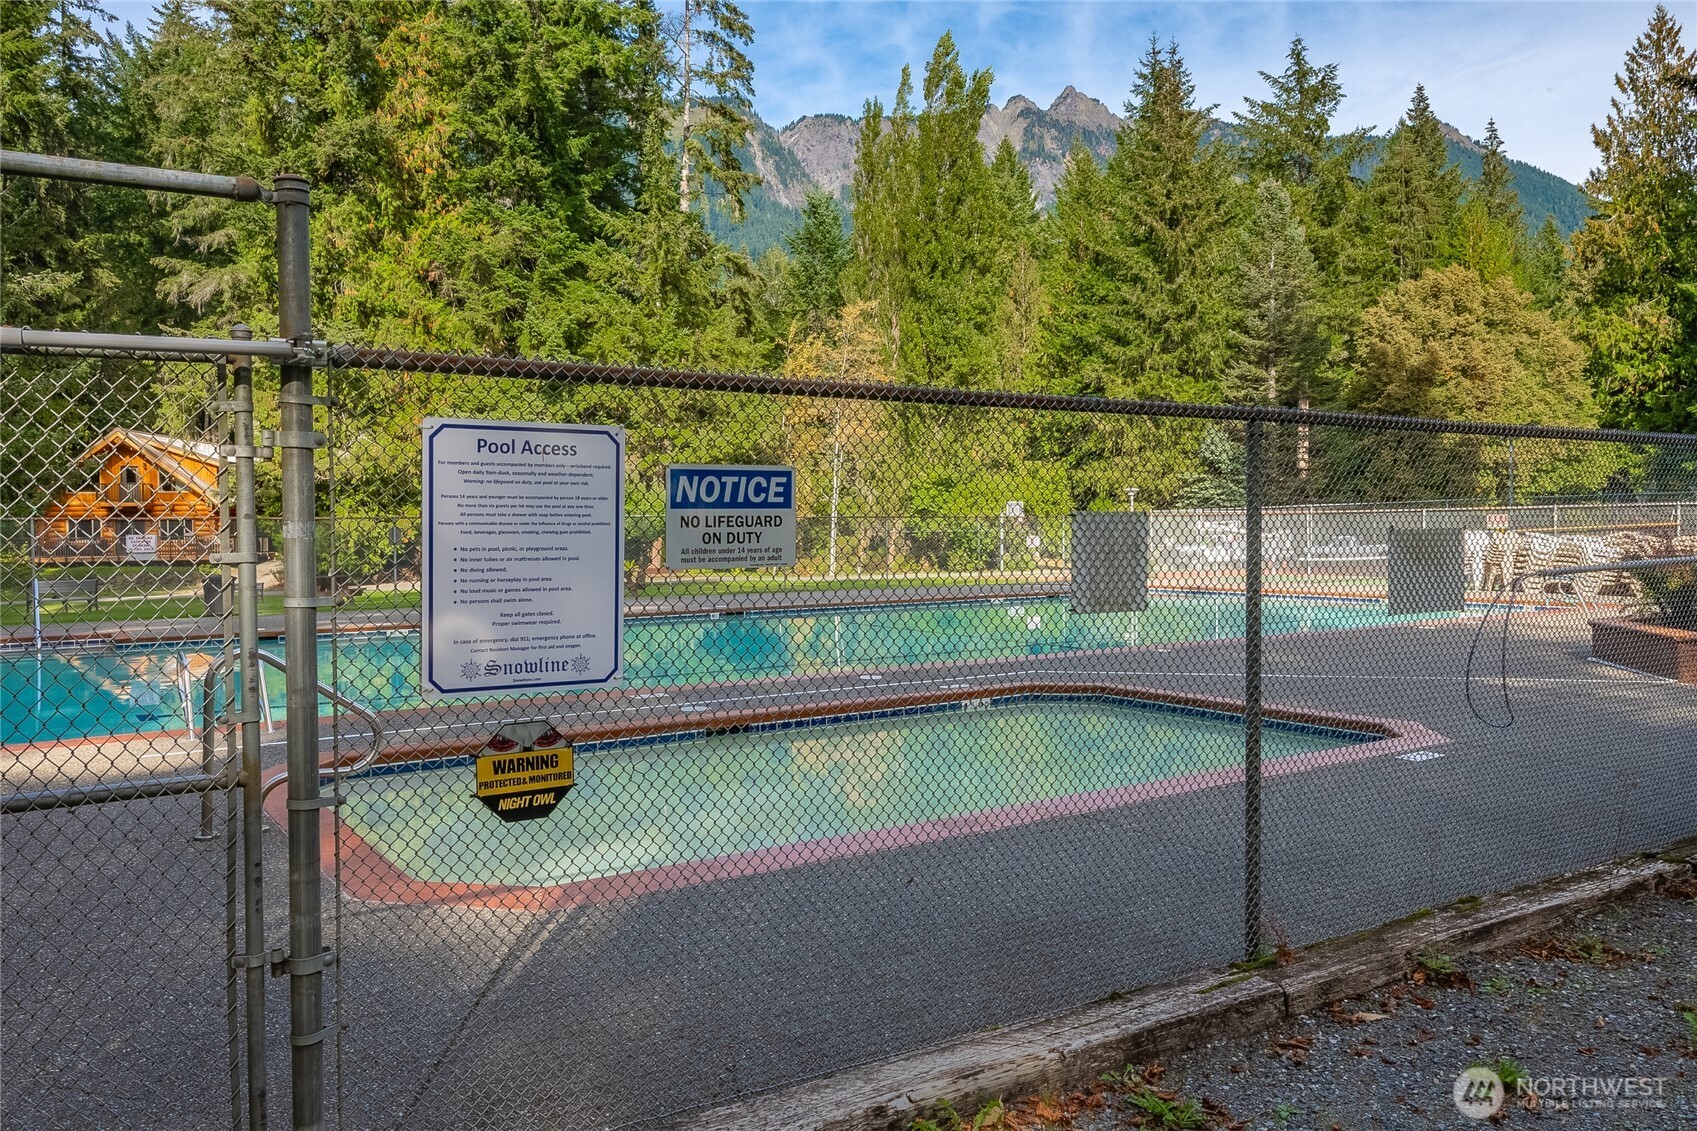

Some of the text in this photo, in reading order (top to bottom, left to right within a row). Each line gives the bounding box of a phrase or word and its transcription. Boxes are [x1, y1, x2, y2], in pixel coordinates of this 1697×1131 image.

[477, 438, 577, 456] Pool Access
[676, 476, 787, 502] NOTICE
[680, 515, 782, 528] NO LIFEGUARD
[702, 532, 762, 544] ON DUTY
[708, 555, 747, 563] accompanied
[750, 555, 756, 563] by
[484, 657, 569, 677] Snowline
[492, 754, 558, 775] WARNING
[479, 777, 521, 790] PROTECTED
[529, 771, 571, 784] MONITORED
[498, 792, 556, 811] NIGHT OWL
